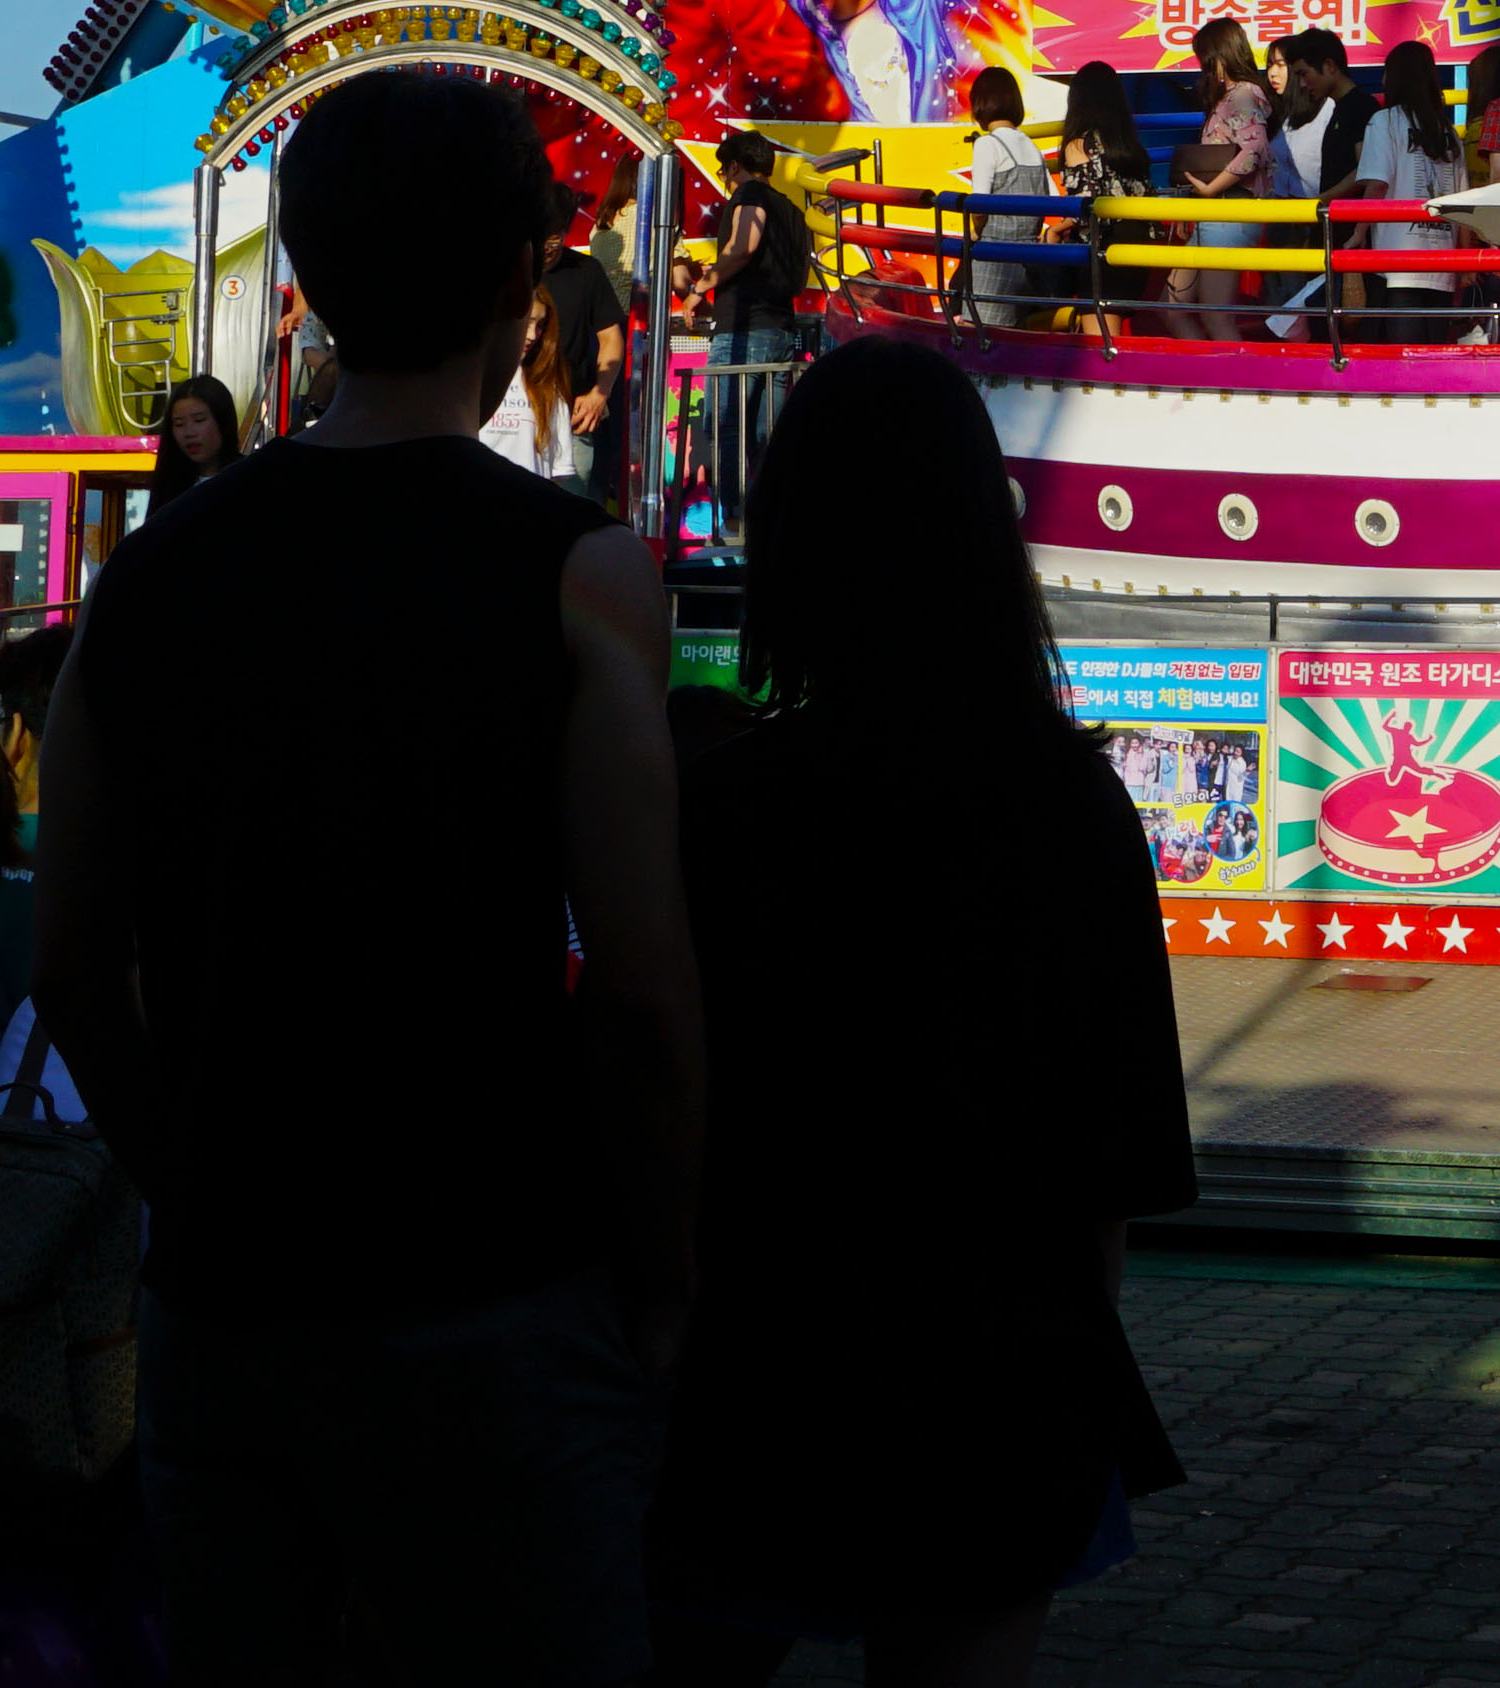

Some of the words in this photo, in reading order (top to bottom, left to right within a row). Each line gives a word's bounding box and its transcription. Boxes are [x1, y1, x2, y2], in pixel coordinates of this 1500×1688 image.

[227, 279, 238, 296] 3
[1168, 662, 1225, 680] 거침없는
[1228, 663, 1262, 681] 입담!
[1289, 661, 1375, 686] 대한민국
[1379, 662, 1423, 688] 원조
[1060, 685, 1119, 707] 드에서
[1124, 689, 1154, 709] 직접
[1158, 687, 1259, 711] 체험해보세요!
